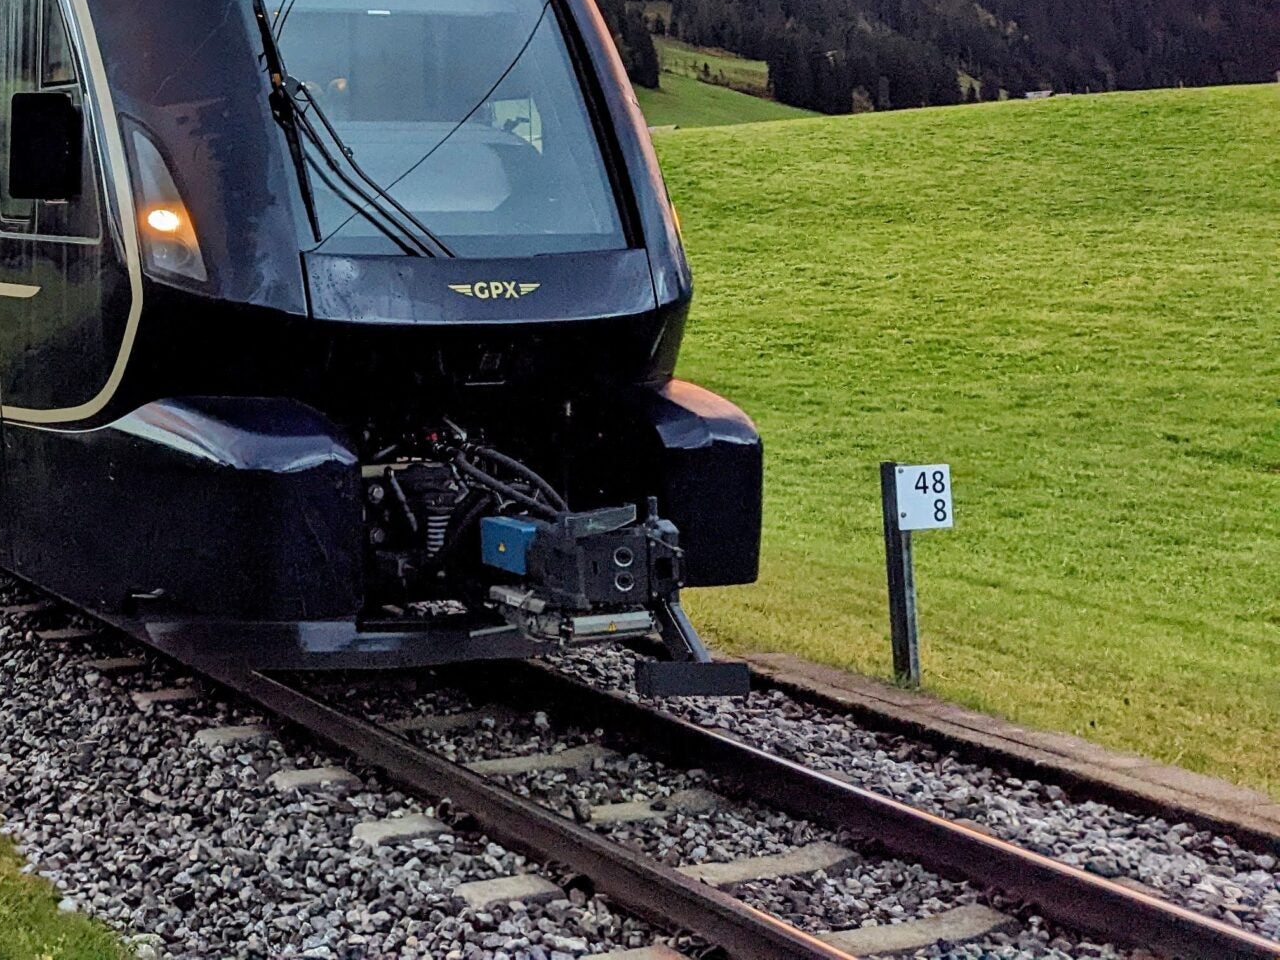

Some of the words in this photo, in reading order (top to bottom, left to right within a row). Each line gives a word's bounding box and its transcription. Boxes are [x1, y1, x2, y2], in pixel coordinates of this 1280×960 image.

[473, 281, 519, 299] GPX
[914, 470, 945, 495] 48
[933, 498, 947, 522] 8
